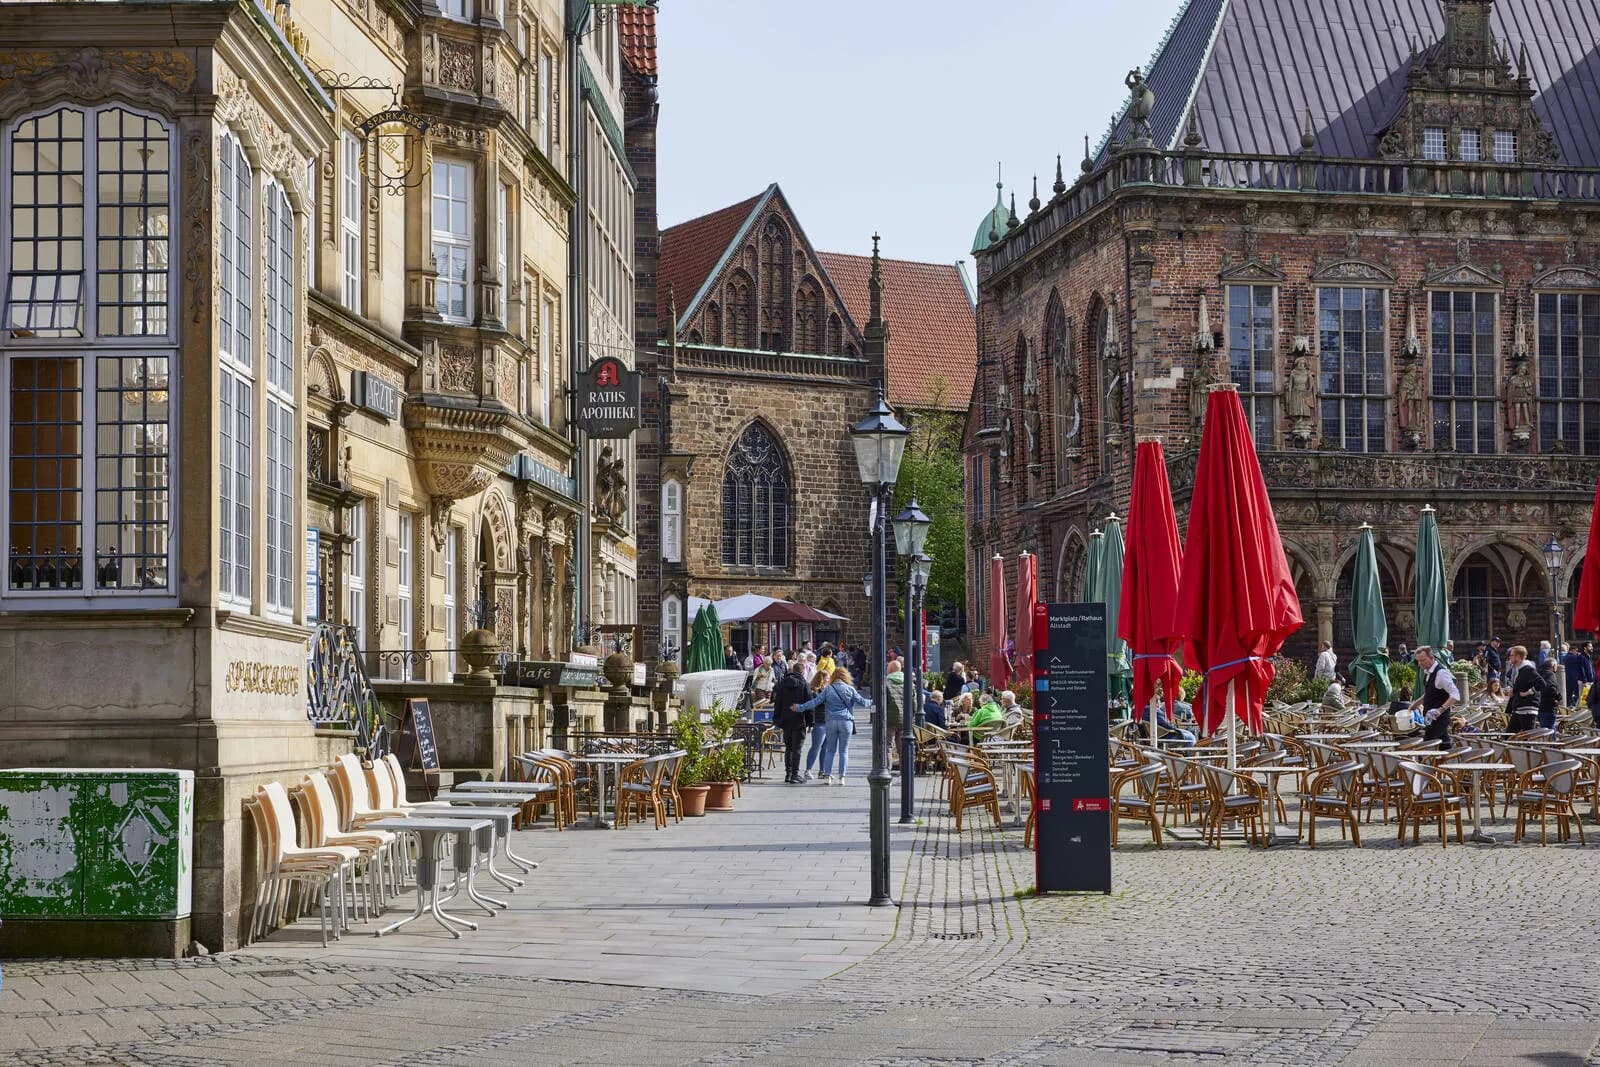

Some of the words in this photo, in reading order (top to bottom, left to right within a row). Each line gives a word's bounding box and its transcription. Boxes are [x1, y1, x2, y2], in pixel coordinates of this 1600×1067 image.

[367, 111, 425, 129] SPARKASSE
[589, 391, 626, 403] RATHS
[580, 406, 636, 419] APOTHEKE
[530, 461, 570, 498] APOTHEKE
[515, 666, 553, 680] Café
